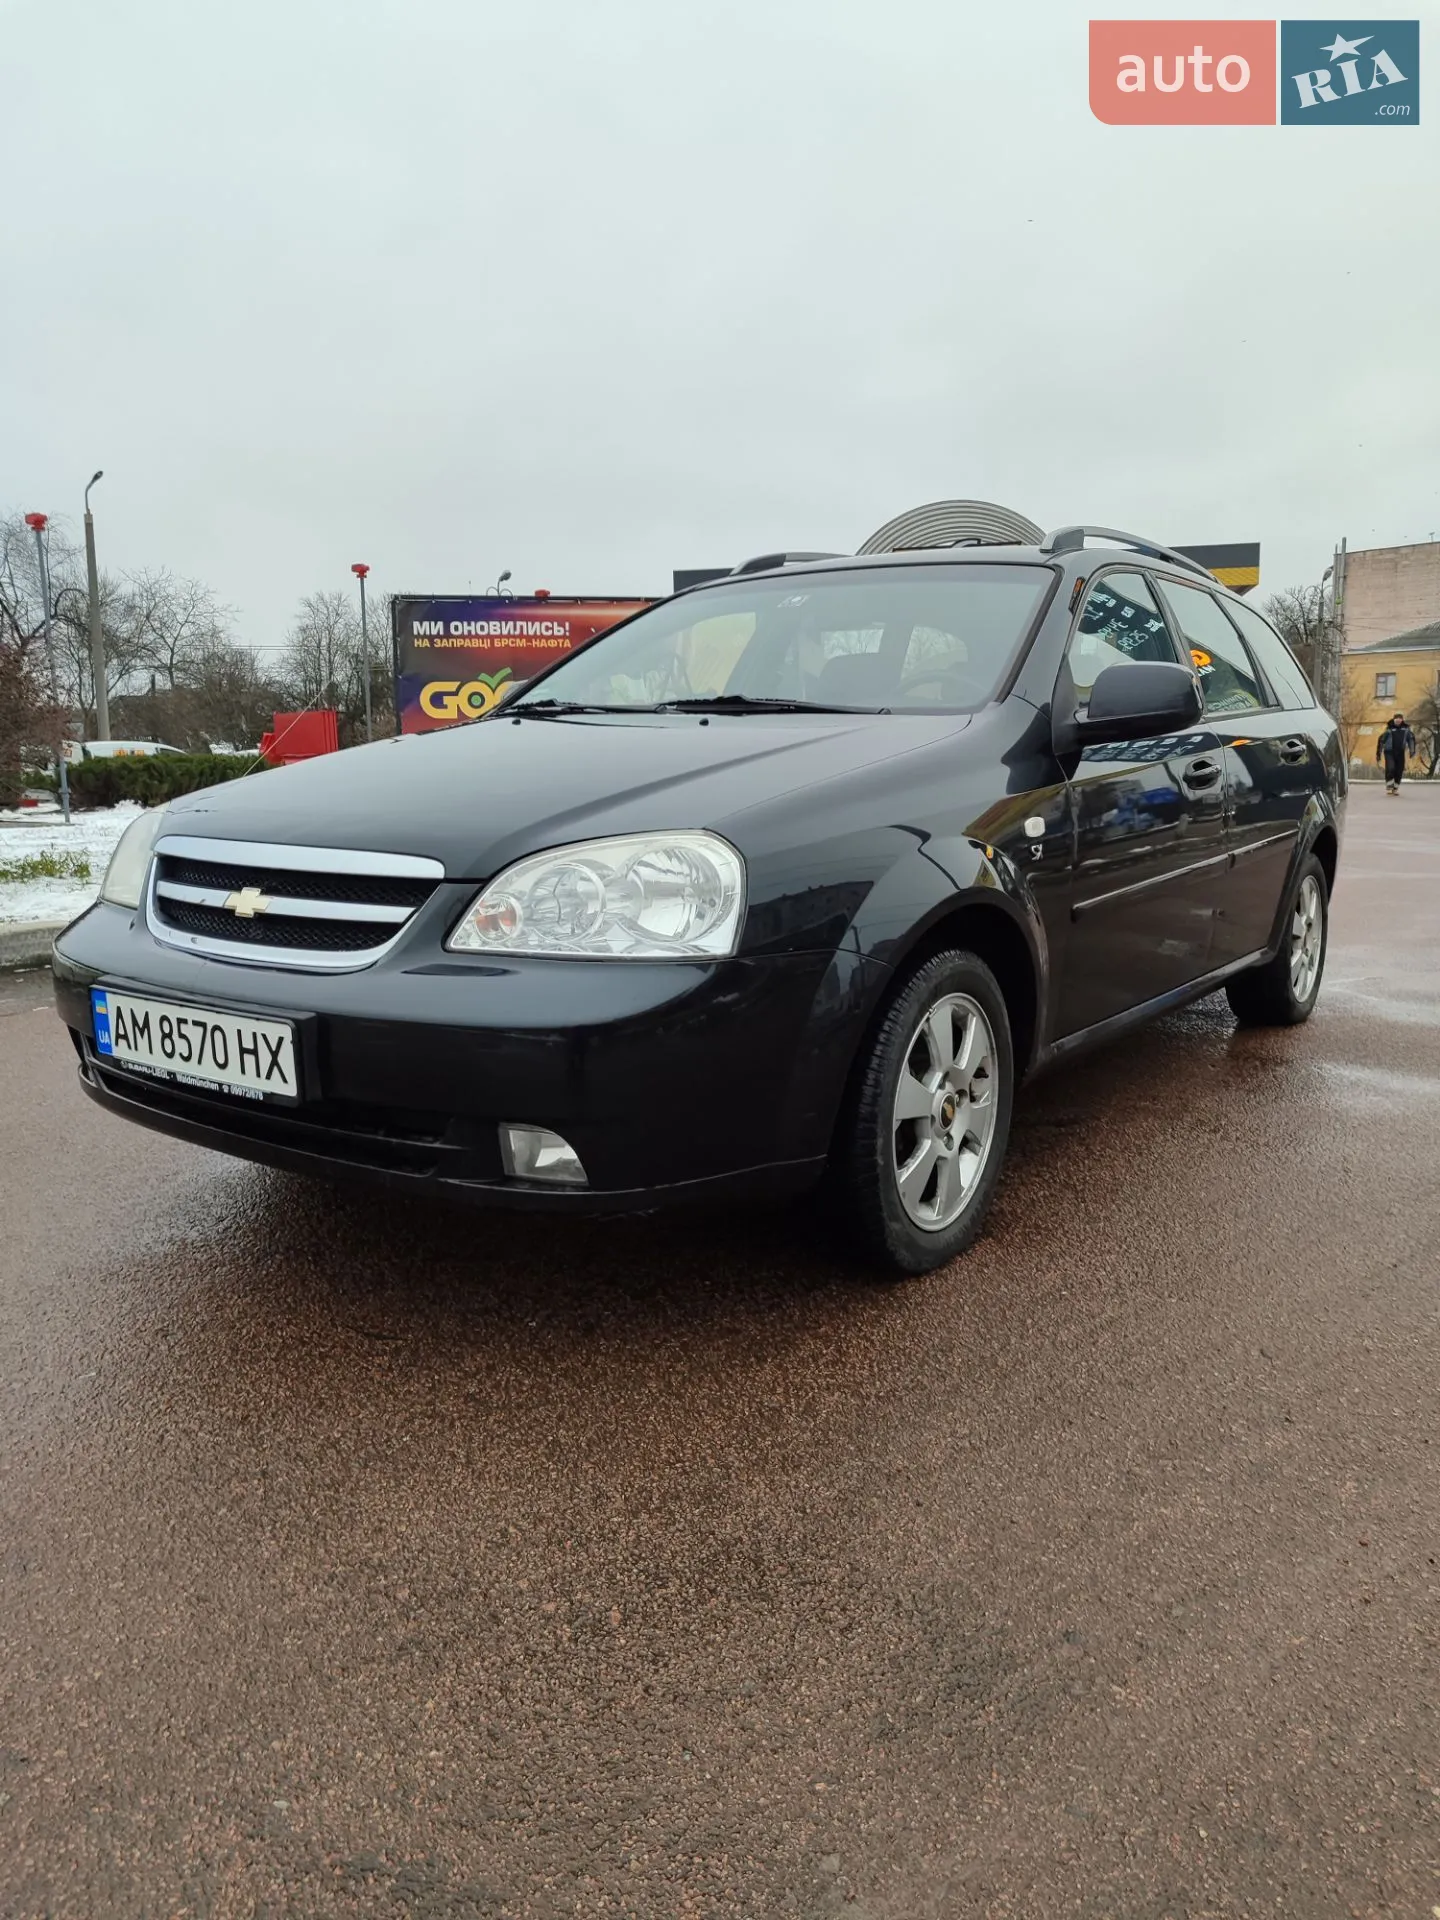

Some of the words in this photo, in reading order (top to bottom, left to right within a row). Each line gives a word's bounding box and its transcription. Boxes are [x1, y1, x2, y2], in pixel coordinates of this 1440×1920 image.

[413, 621, 444, 636] МИ
[450, 621, 570, 637] ОНОВИЛИСЬ!
[414, 638, 430, 648] НА
[434, 638, 491, 650] ЗАПРАВЦІ
[494, 638, 572, 648] БРСМ-НАФТА
[420, 680, 514, 720] GO
[99, 1030, 110, 1044] UA
[115, 1006, 153, 1055] AM
[159, 1015, 229, 1070] 8570
[237, 1029, 289, 1085] HX
